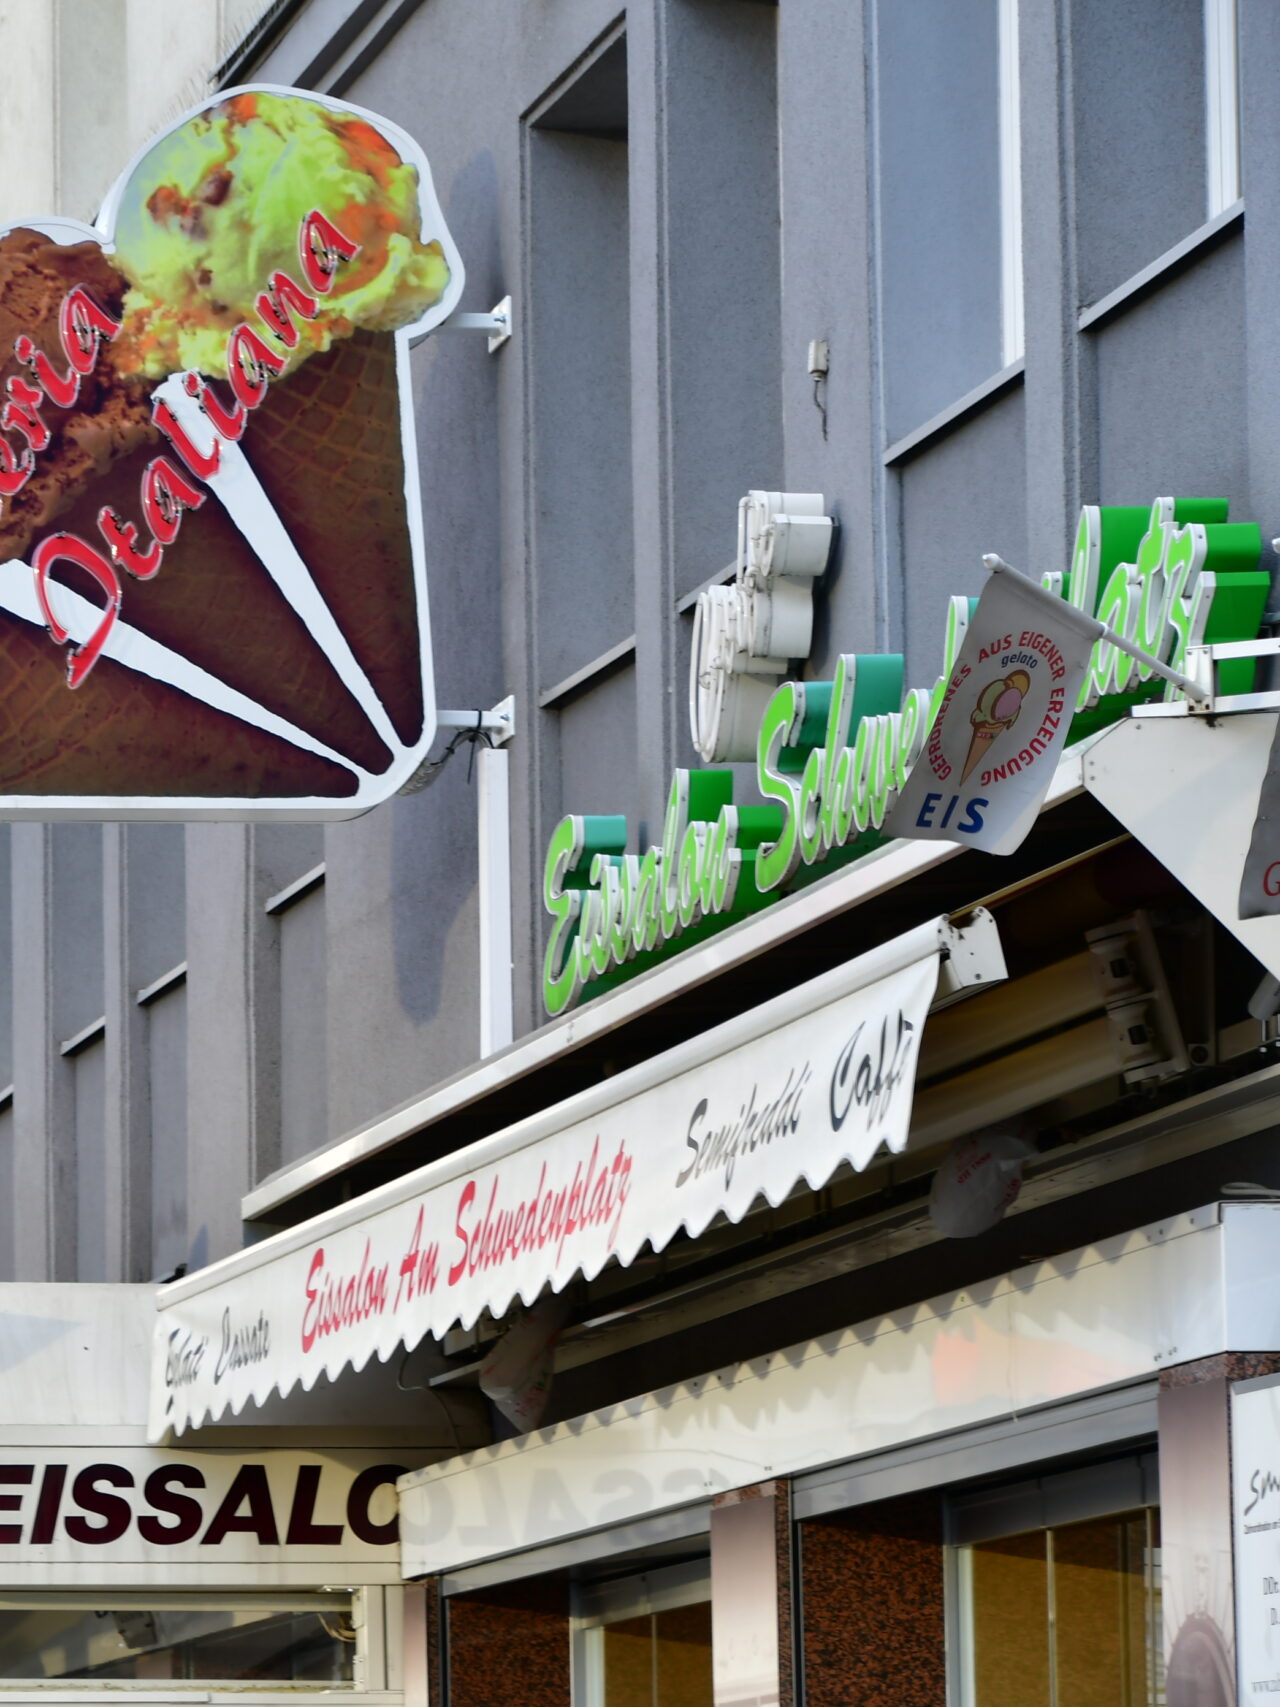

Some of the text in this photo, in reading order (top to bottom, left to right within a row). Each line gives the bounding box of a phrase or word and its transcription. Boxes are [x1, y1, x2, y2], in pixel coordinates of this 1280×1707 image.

[32, 208, 362, 689] Italiana
[978, 634, 1013, 663] AUS
[1001, 651, 1038, 669] gelato
[1018, 631, 1066, 681] EIGENER
[981, 687, 1065, 787] ERZEUGUNG
[915, 792, 989, 834] EIS
[301, 1134, 633, 1354] Eissalon Am Schwedenplatz
